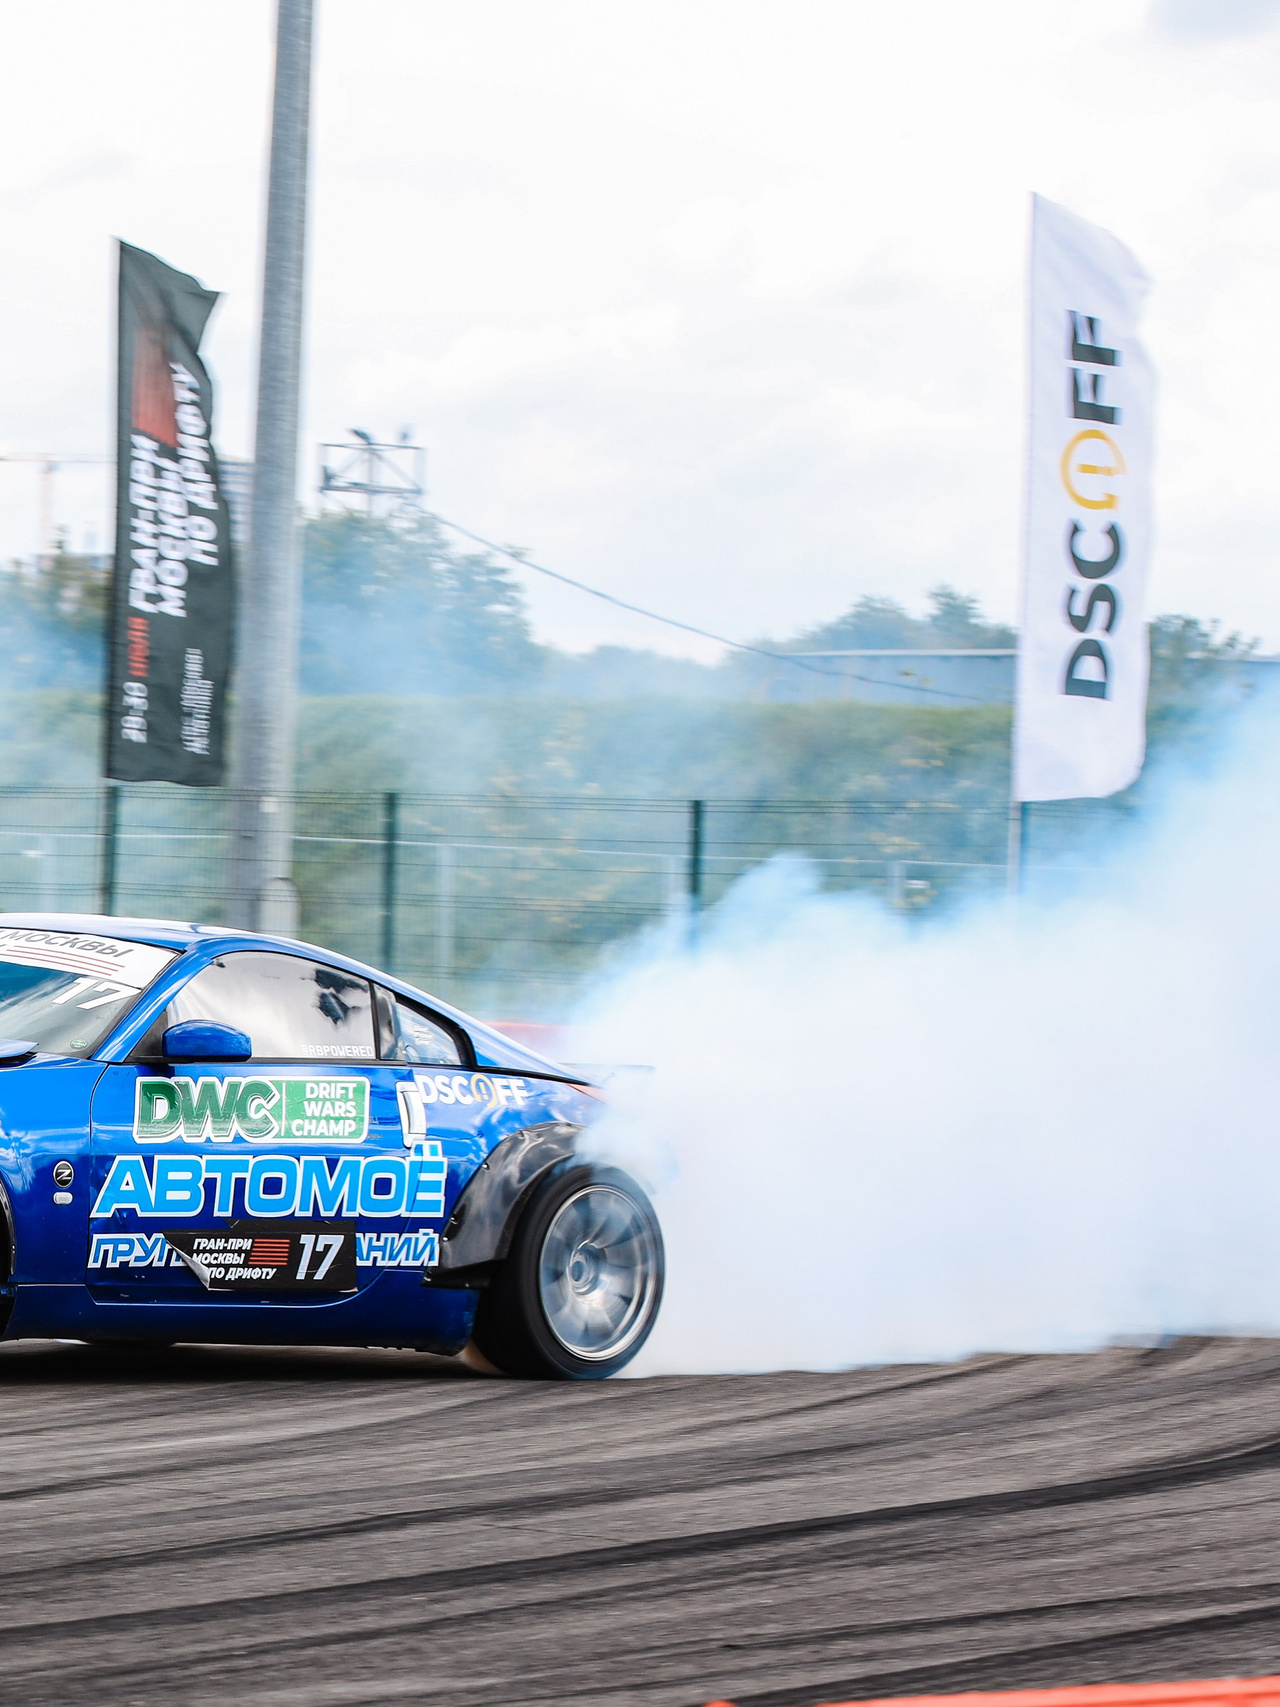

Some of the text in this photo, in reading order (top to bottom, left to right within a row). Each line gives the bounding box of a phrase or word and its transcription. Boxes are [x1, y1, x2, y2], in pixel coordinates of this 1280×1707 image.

[0, 931, 133, 958] МОСКВЫ
[51, 976, 141, 1010] 17
[305, 1081, 357, 1100] DRIFT
[134, 1077, 278, 1143] DWC
[303, 1100, 357, 1118] WARS
[291, 1118, 357, 1138] CHAMP
[90, 1141, 447, 1218] АВТОМОЁ
[193, 1238, 252, 1250] ГРАН-ПРИ
[192, 1252, 245, 1265] МОСКВЫ
[295, 1234, 344, 1280] 17
[208, 1266, 277, 1280] ПО ДРИФТУ
